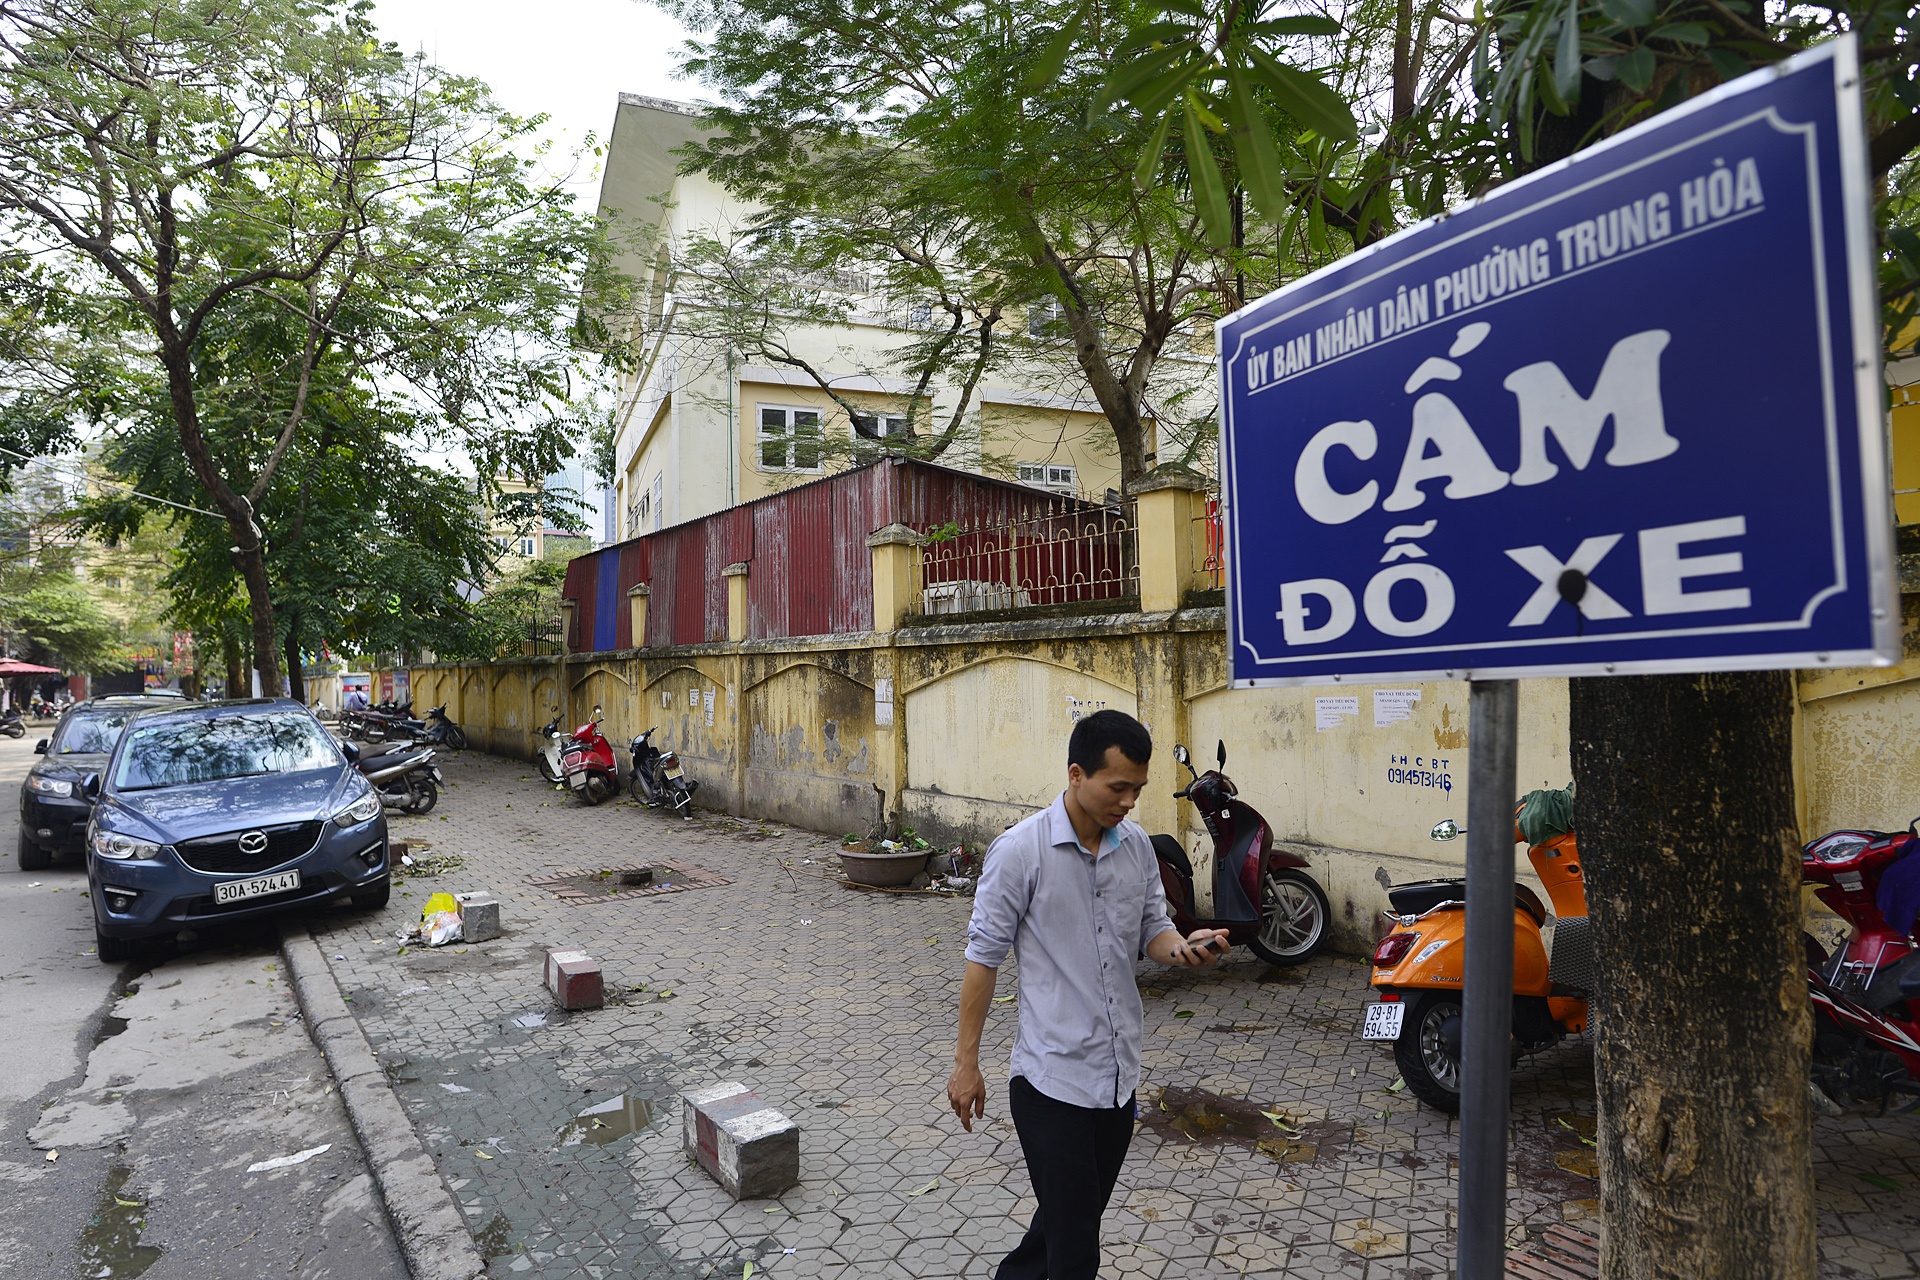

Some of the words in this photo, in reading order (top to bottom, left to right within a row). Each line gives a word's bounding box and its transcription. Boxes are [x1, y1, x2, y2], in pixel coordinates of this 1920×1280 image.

[1246, 345, 1270, 390] ỦY
[1273, 332, 1312, 381] BAN
[1315, 307, 1375, 363] NHÂN
[1379, 285, 1430, 339] DÂN
[1434, 237, 1551, 318] PHƯỜNG
[1556, 191, 1672, 272] TRUNG
[1679, 156, 1766, 231] HÒA
[1294, 321, 1681, 525] CẤM
[1275, 518, 1457, 646] ĐỖ
[1503, 514, 1752, 628] XE
[1388, 768, 1452, 792] 0914573146
[219, 874, 296, 900] 30A-524.41
[1370, 1005, 1399, 1021] 29-B1
[1364, 1021, 1399, 1038] 594.55
